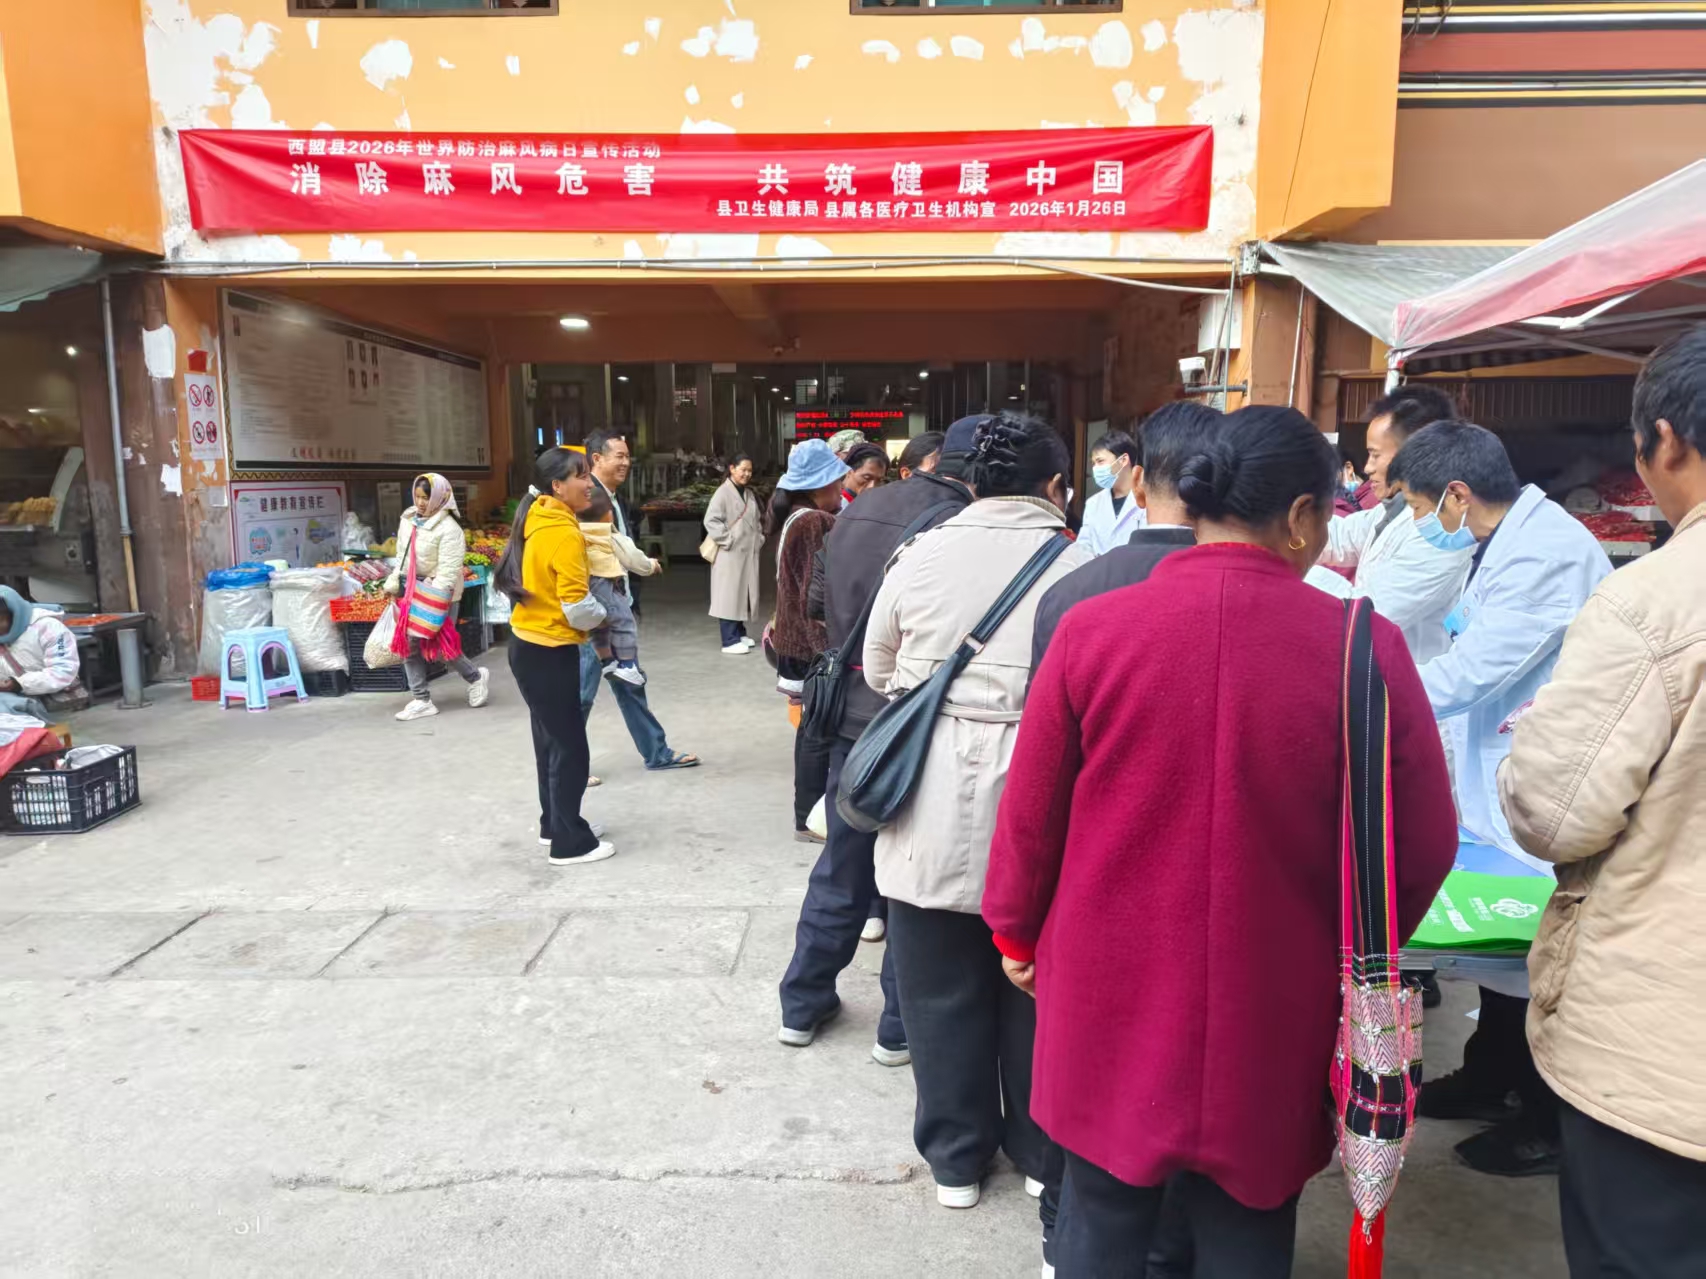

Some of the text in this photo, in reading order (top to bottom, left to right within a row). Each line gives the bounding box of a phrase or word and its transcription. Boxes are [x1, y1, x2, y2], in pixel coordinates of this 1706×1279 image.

[287, 138, 661, 159] 西盟县2026年世界防治麻风病日宣传活动
[289, 160, 1124, 196] 消除麻风危害 共筑健康中国
[716, 200, 1126, 218] 县卫生健康局 县属各医疗卫生机构宣 2026年1月26日
